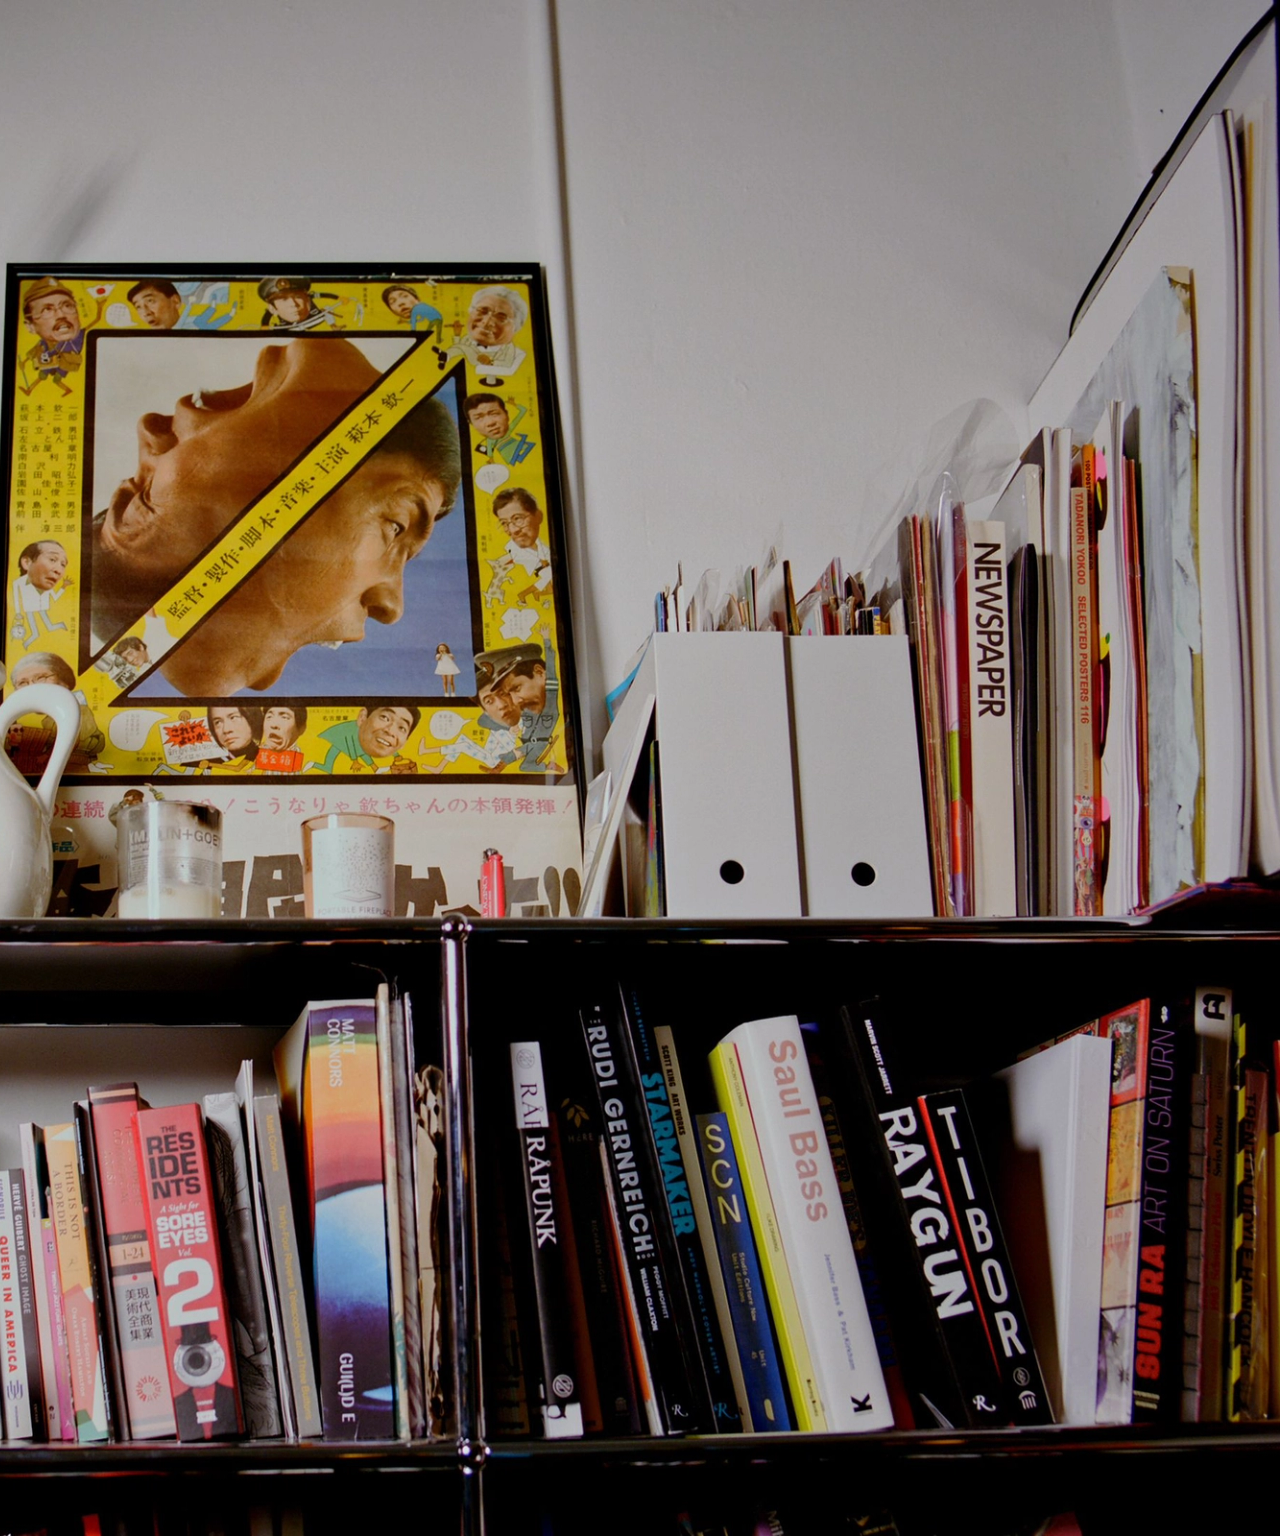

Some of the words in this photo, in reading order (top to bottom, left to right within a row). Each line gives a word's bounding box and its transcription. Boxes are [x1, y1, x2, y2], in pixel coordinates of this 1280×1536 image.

[1074, 491, 1086, 545] TADANORI
[1076, 548, 1087, 585] YOKOO
[973, 542, 1006, 718] NEWSPAPER
[1077, 595, 1088, 650] SELECTED
[1079, 652, 1089, 704] POSTERS
[1080, 705, 1090, 724] 116
[317, 906, 357, 915] PORTABLE
[342, 1018, 355, 1055] MATT
[864, 1019, 878, 1043] MARVIN
[326, 1018, 343, 1089] CONNORS
[661, 1044, 673, 1067] SCOTT
[870, 1043, 884, 1067] SCOTT
[665, 1068, 676, 1088] KING
[876, 1067, 893, 1094] JARRETT
[1146, 1028, 1176, 1130] SATURN
[671, 1093, 680, 1107] ART
[159, 1125, 178, 1134] THE
[673, 1108, 686, 1136] WORKS
[1213, 1114, 1225, 1148] Poster
[146, 1131, 196, 1156] RES
[587, 1024, 619, 1088] RUDI
[604, 1097, 654, 1260] GERNREICH
[642, 1072, 696, 1238] STARMAKER
[149, 1152, 200, 1179] IDE
[1146, 1140, 1170, 1173] ON
[1212, 1150, 1224, 1178] Swiss
[52, 1170, 60, 1178] A
[64, 1161, 75, 1194] THIS
[768, 1039, 798, 1119] Saul
[788, 1130, 828, 1223] Bass
[824, 1253, 836, 1285] Jennifer
[831, 1286, 841, 1307] Bass
[840, 1320, 848, 1334] Pat
[11, 1183, 24, 1212] HERVÉ
[151, 1176, 202, 1201] NTS
[526, 1134, 558, 1249] RÅPUNK
[53, 1184, 68, 1236] BORDER
[67, 1197, 77, 1211] IS
[160, 1205, 168, 1214] A
[168, 1201, 187, 1214] Sight
[188, 1200, 200, 1211] for
[878, 1105, 975, 1320] RAYGUN
[1142, 1182, 1168, 1234] ART
[14, 1215, 26, 1251] GUIBERT
[69, 1214, 81, 1241] NOT
[156, 1210, 206, 1234] SORE
[936, 1105, 1027, 1358] TIBOR
[158, 1226, 209, 1250] EYES
[178, 1248, 193, 1257] Vol.
[18, 1255, 29, 1283] GHOST
[652, 1265, 663, 1288] PEGGY
[1140, 1244, 1166, 1296] RA
[2, 1287, 13, 1303] IN
[21, 1286, 32, 1314] IMAGE
[163, 1257, 220, 1328] 2
[639, 1267, 651, 1296] WILLIAM
[645, 1297, 659, 1332] CLAXTON
[657, 1289, 669, 1319] MOFFITT
[1136, 1303, 1164, 1381] SUN
